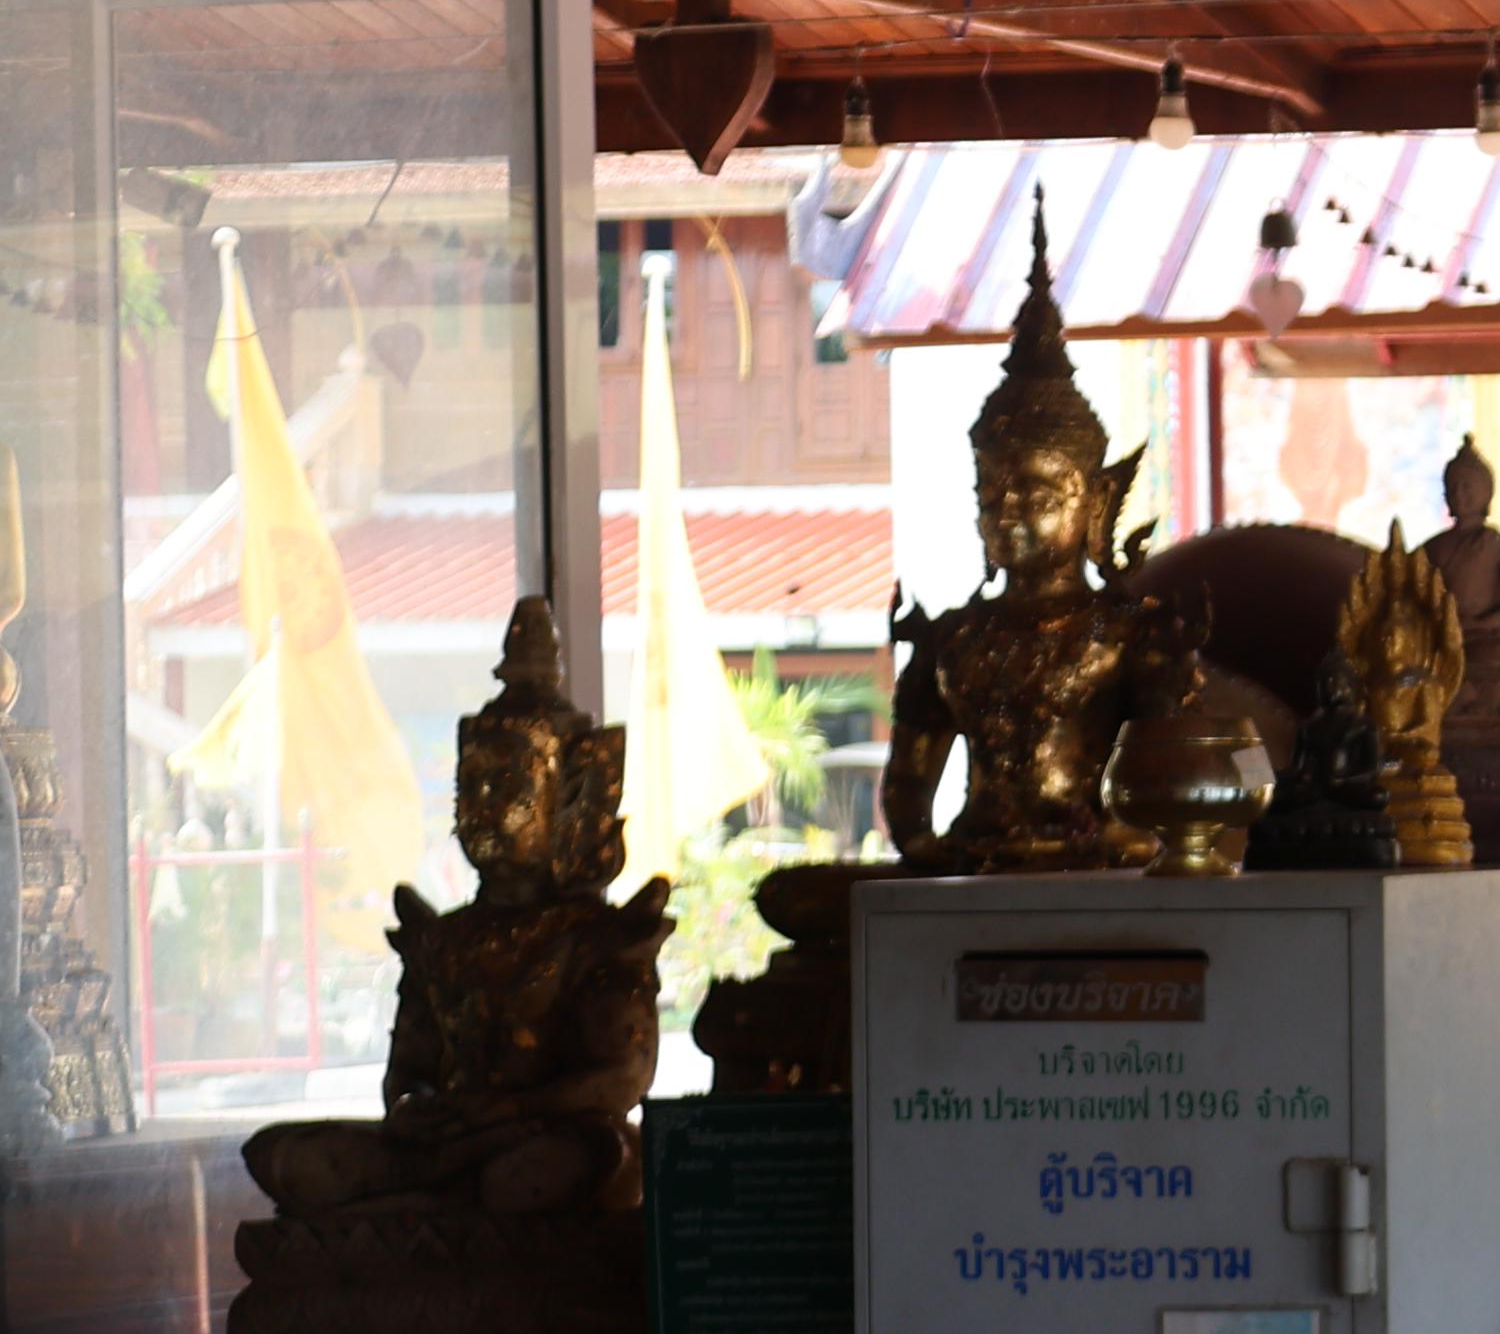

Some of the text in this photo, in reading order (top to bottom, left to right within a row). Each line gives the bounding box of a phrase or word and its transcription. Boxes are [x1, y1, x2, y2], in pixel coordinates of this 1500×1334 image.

[978, 971, 1179, 1014] ช่องบริจาค
[893, 1086, 973, 1122] บริษัท
[1160, 1089, 1240, 1121] 1996
[1256, 1085, 1330, 1121] จำกัด
[1039, 1151, 1193, 1215] ตู้บริจาค
[953, 1230, 1253, 1298] บำรุงพระอาราม
